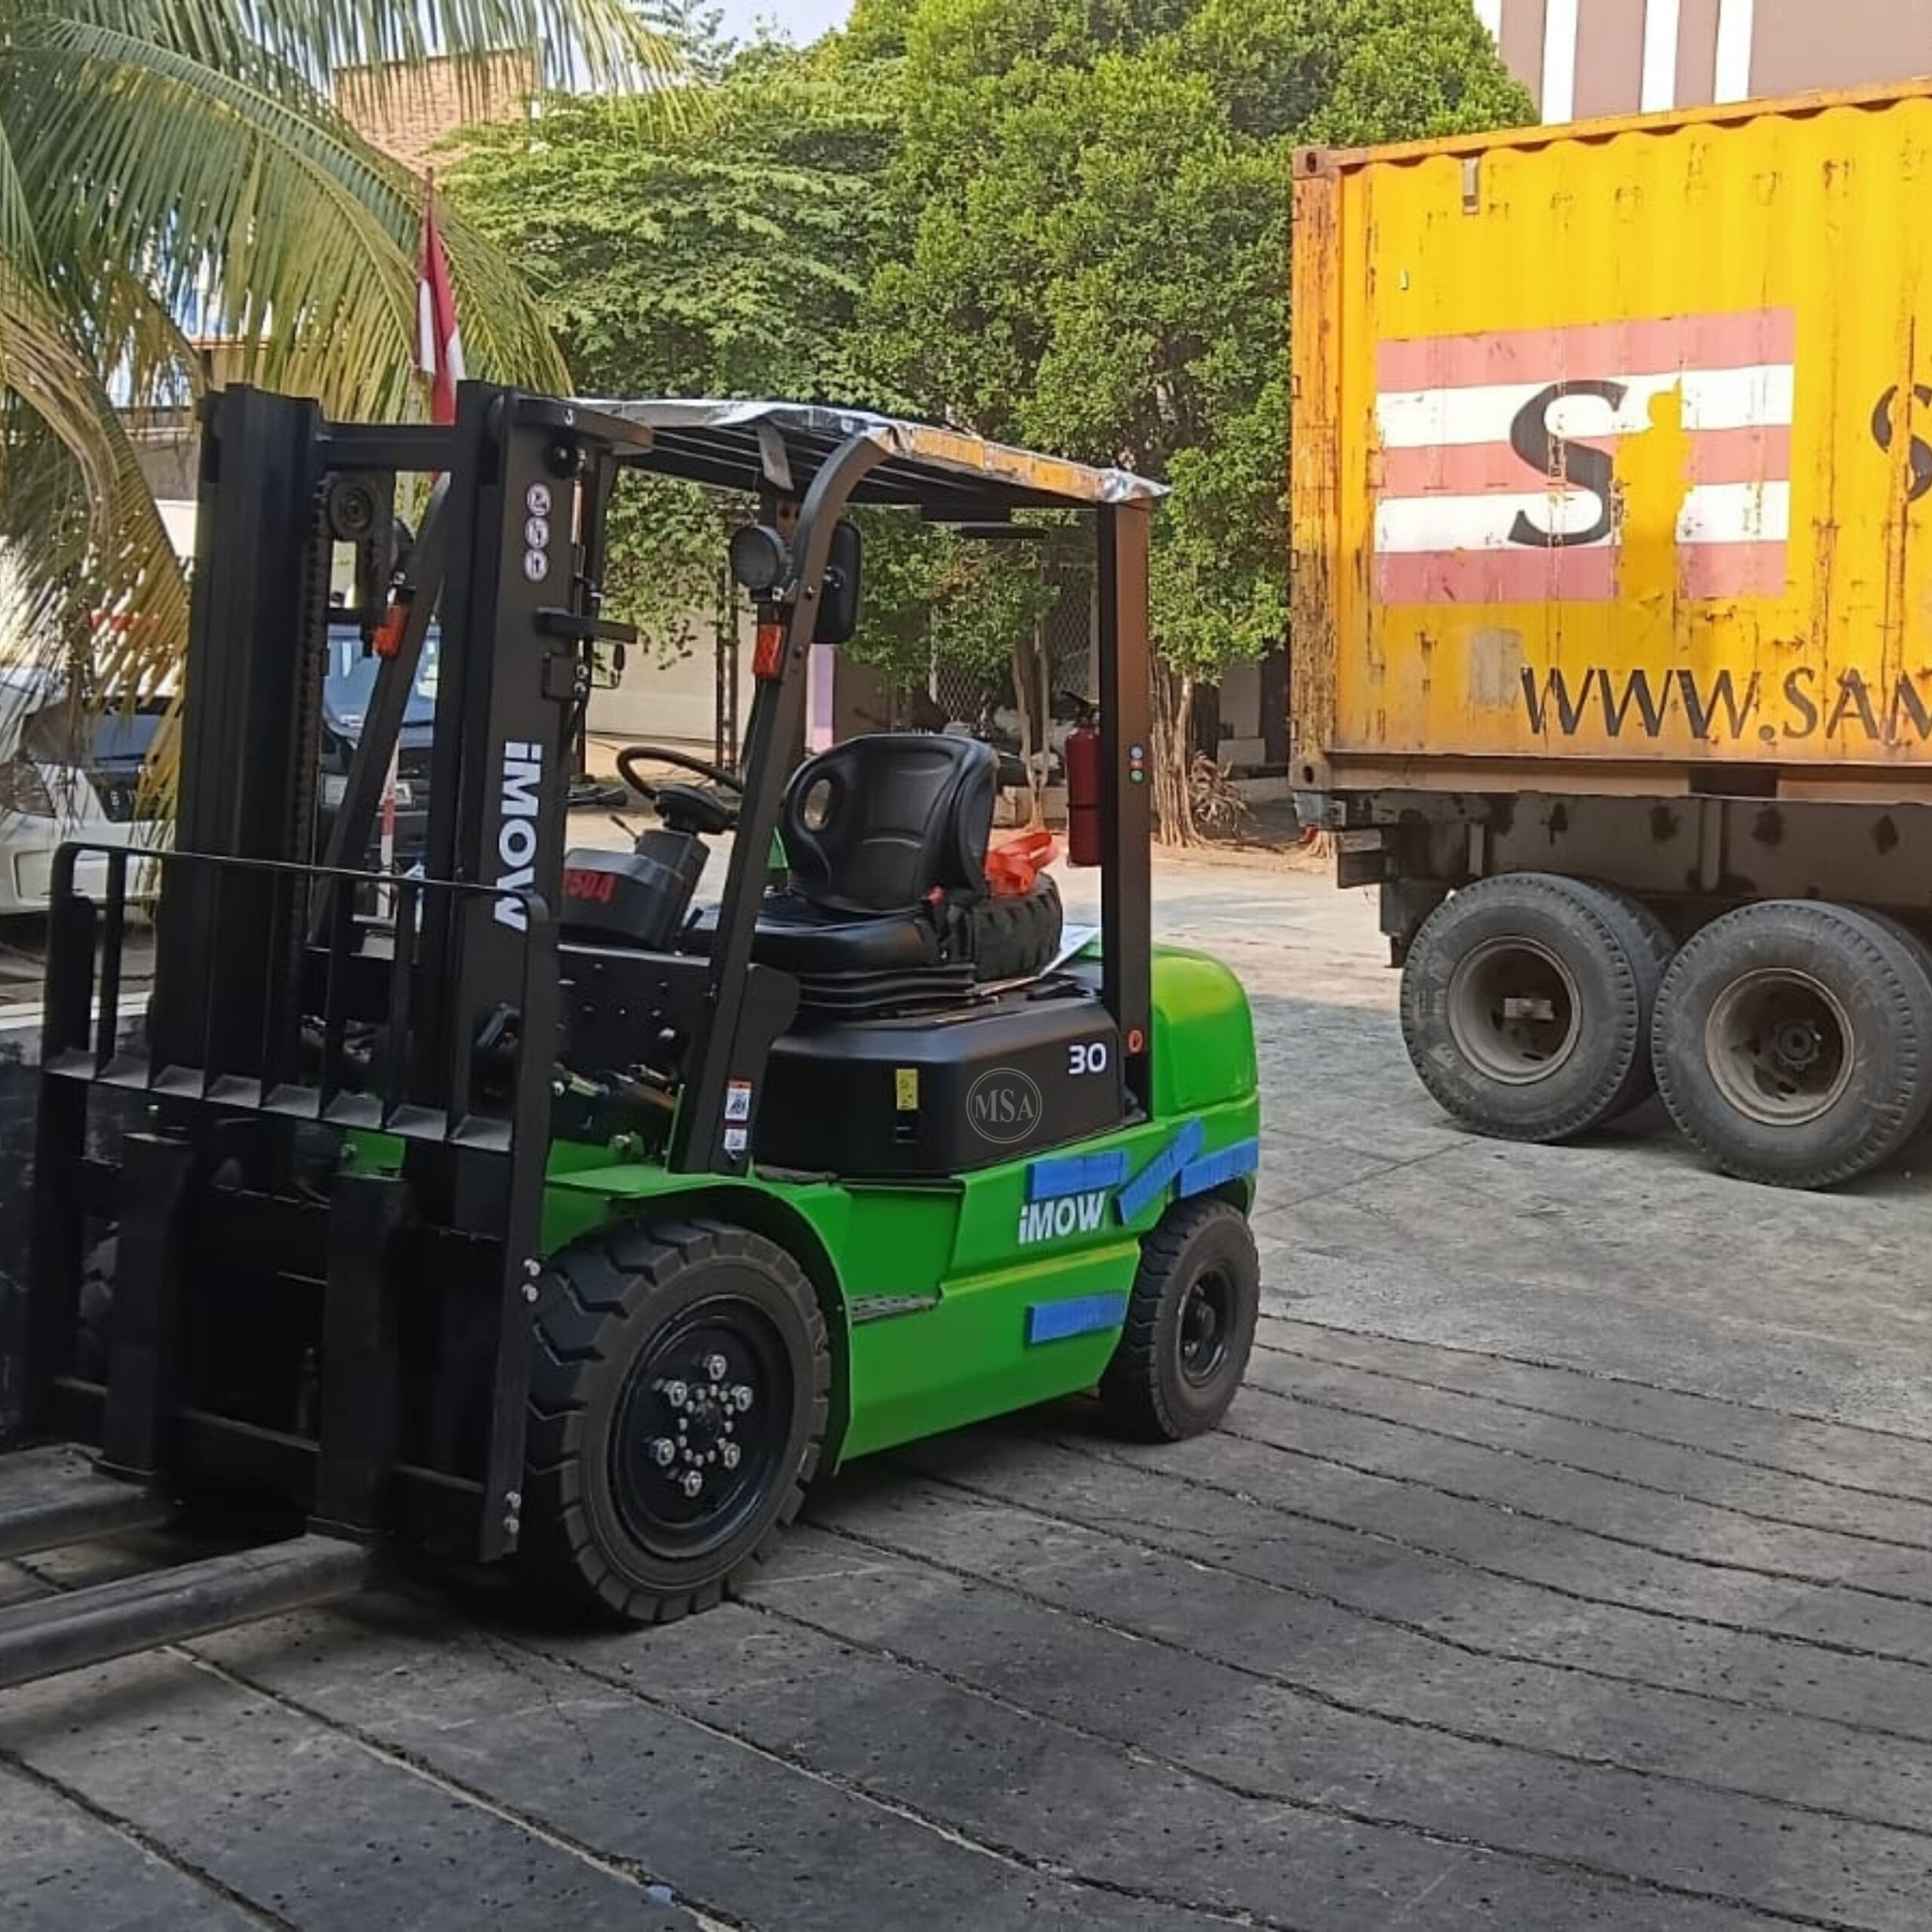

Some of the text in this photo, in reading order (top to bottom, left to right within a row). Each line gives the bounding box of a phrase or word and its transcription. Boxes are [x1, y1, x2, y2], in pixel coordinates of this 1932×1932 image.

[494, 741, 543, 931] iMOW
[1068, 1042, 1107, 1074] 30
[1017, 1191, 1106, 1244] iMOW
